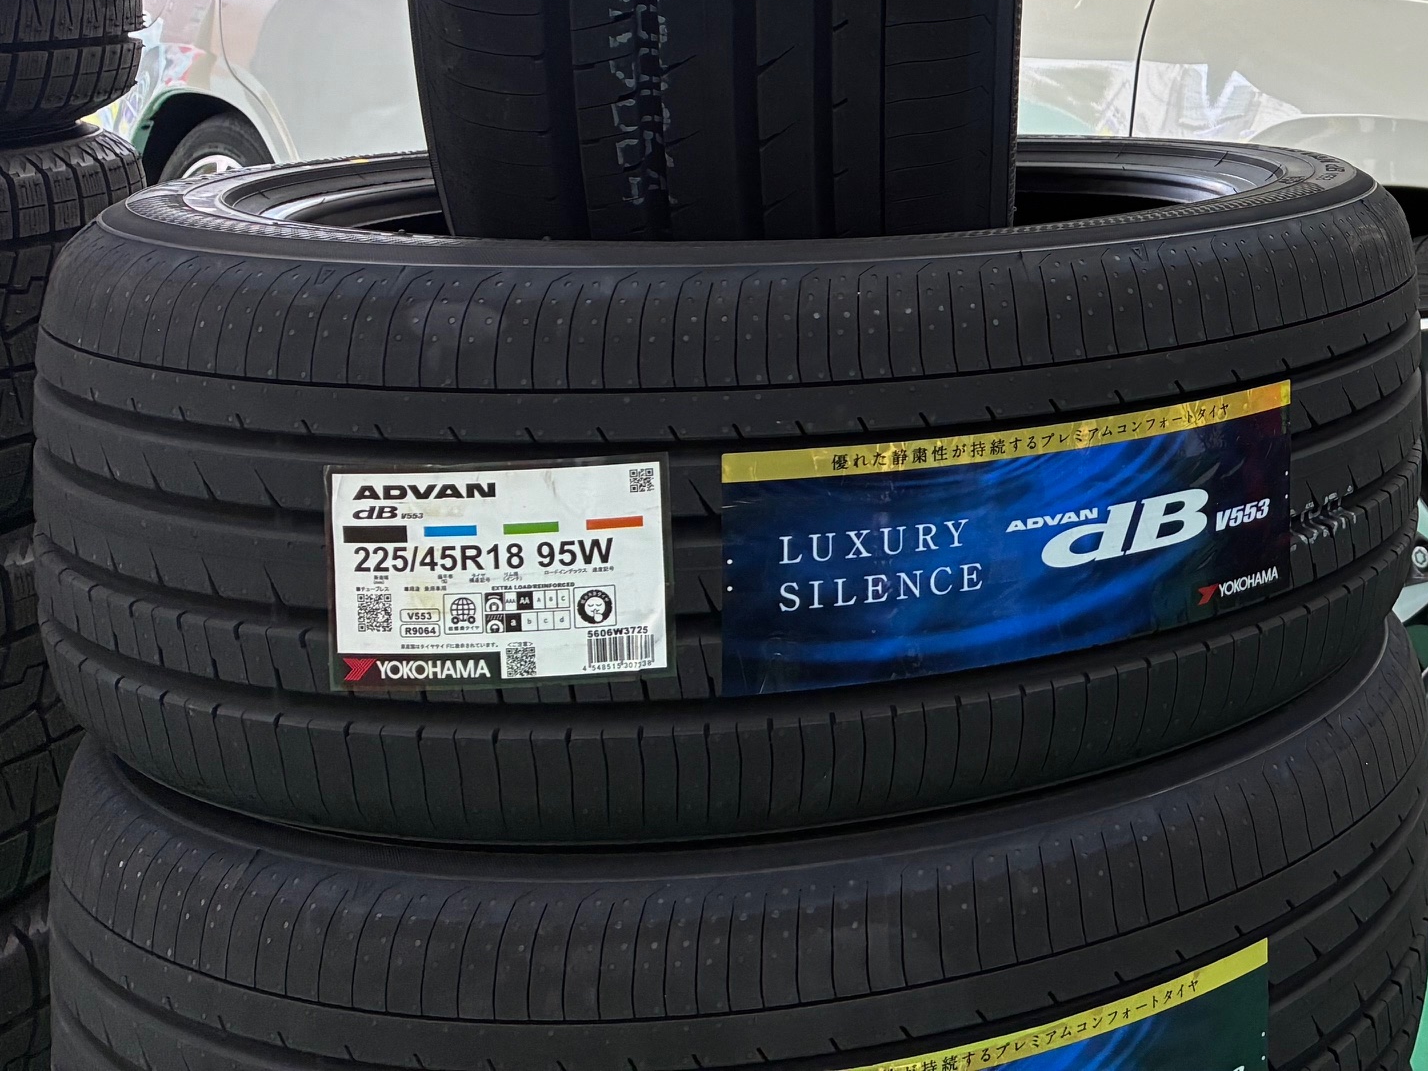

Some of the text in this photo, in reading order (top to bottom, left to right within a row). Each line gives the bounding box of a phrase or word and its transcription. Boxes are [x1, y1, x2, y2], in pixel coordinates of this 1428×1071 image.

[831, 402, 1230, 471] 優れた静粛性が持続するプレミアムコンフォートタイヤ
[352, 482, 496, 500] ADVAN
[352, 505, 424, 520] dB V553
[1005, 507, 1099, 533] ADVAN
[1040, 488, 1209, 568] dB
[1215, 498, 1271, 531] V553
[354, 537, 614, 572] 225/45R18 95W
[778, 519, 969, 565] LUXURY
[778, 563, 984, 612] SILENCE
[1218, 566, 1279, 597] YOKOHAMA
[405, 626, 437, 635] R9064
[407, 612, 433, 620] V553
[587, 626, 649, 638] 5606W3725
[376, 660, 491, 679] YOKOHAMA
[884, 979, 1199, 1071] 持続するプレミアムコンフォートタイヤ
